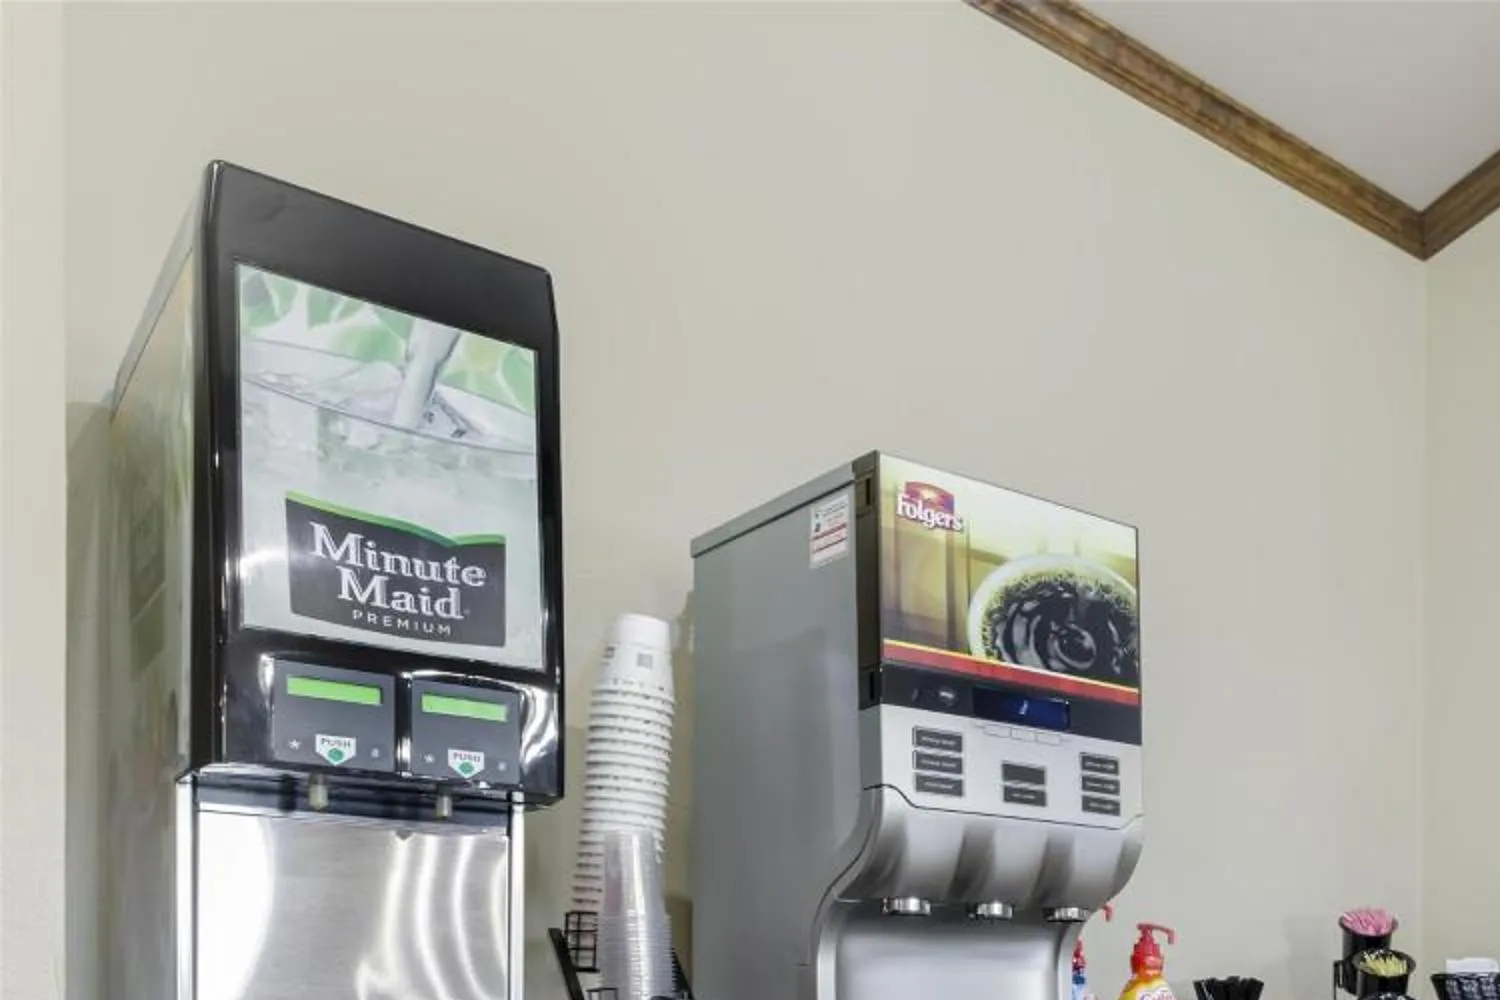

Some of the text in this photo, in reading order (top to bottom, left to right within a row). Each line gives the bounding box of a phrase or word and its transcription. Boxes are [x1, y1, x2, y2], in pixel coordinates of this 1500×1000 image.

[896, 493, 964, 531] Folgers
[308, 520, 487, 588] Minute
[336, 564, 465, 620] Maid
[352, 609, 451, 635] PREMIUM
[320, 736, 352, 750] PUSH
[453, 751, 481, 763] PUSH
